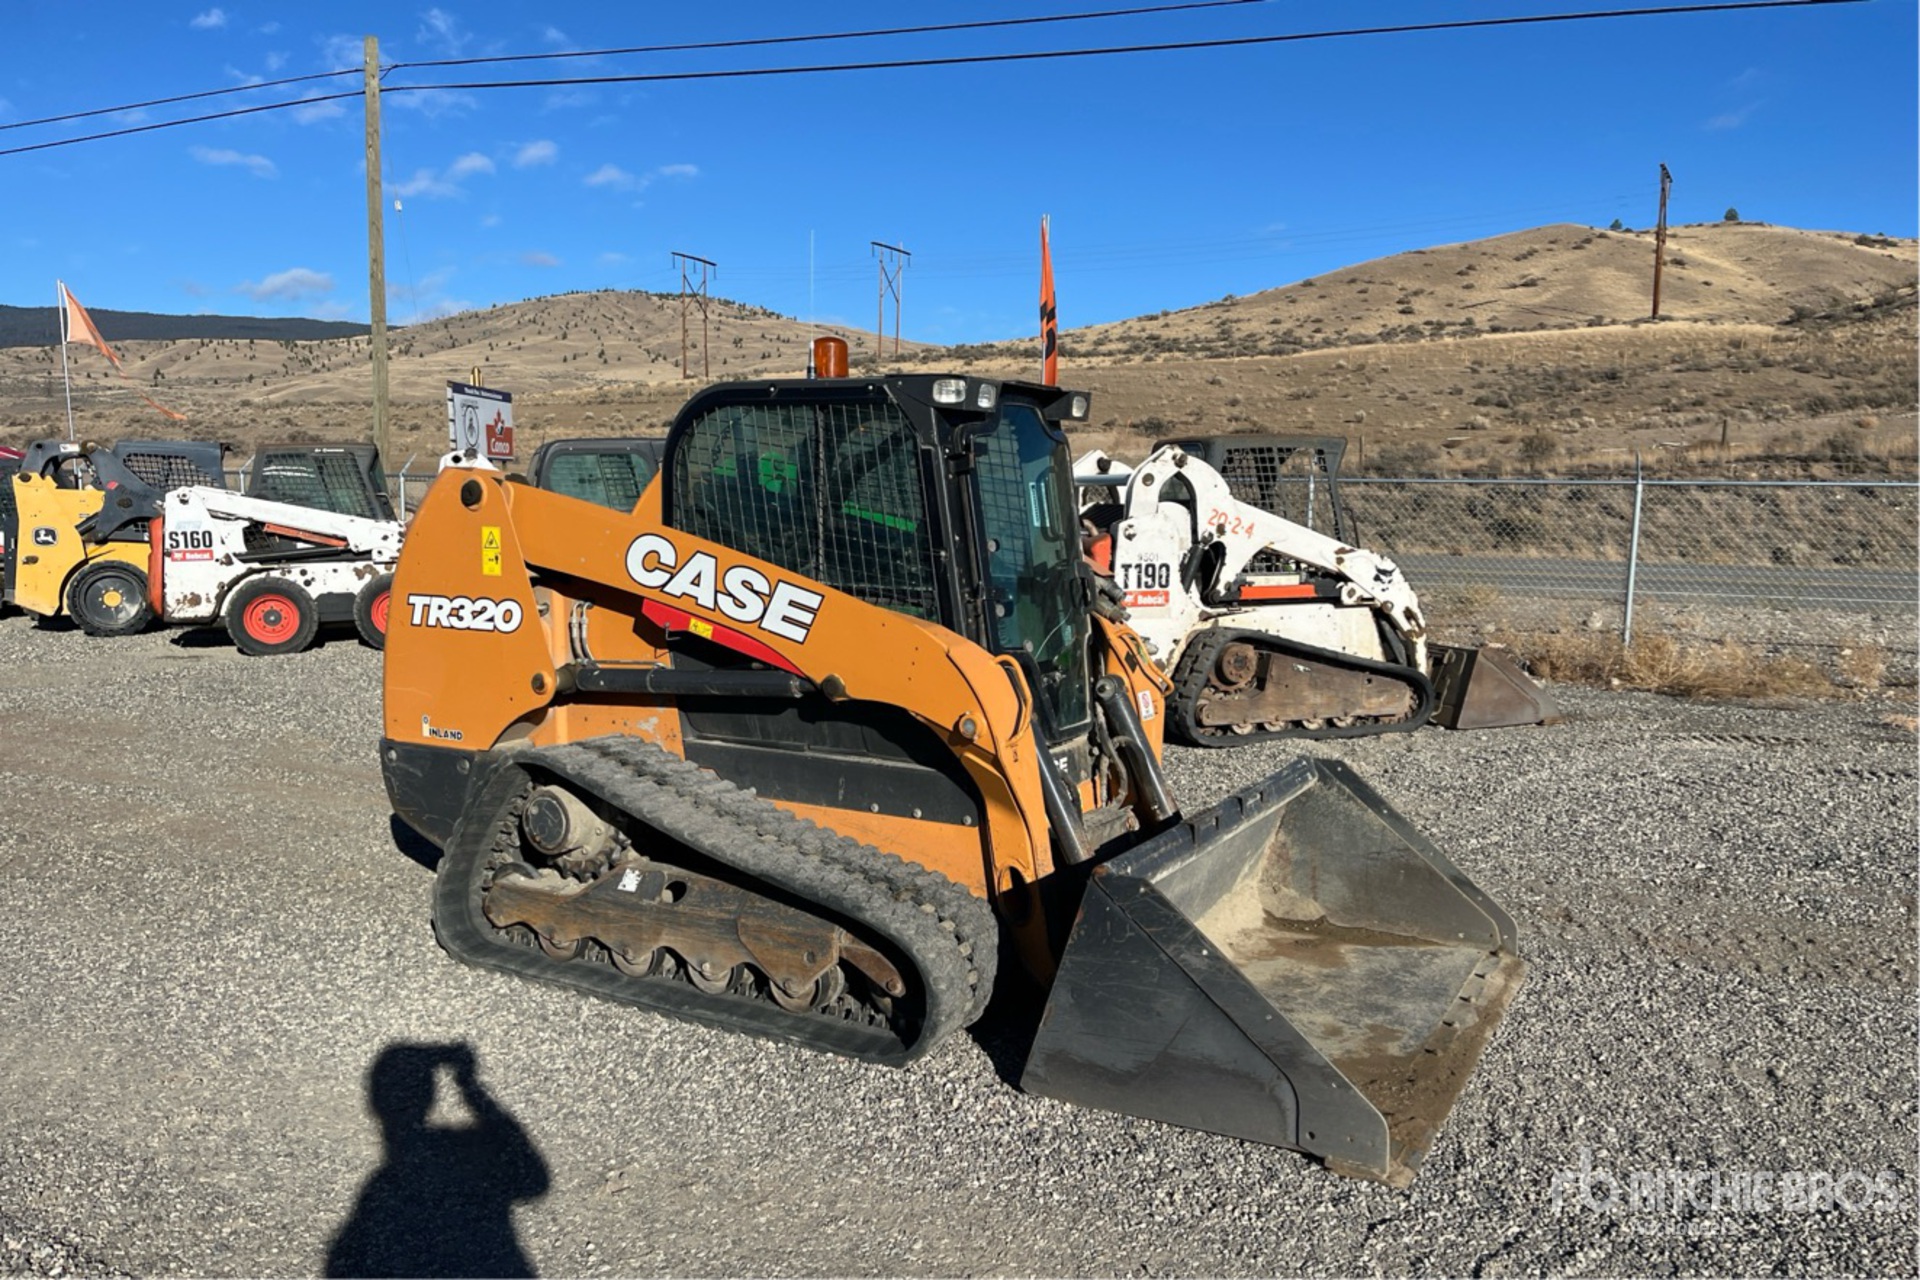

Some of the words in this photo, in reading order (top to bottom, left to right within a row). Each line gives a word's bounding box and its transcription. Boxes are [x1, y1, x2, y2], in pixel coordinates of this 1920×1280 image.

[168, 530, 213, 549] S160
[625, 533, 825, 644] CASE
[1121, 562, 1170, 589] T190
[407, 593, 523, 634] TR320
[428, 727, 464, 741] INLAND
